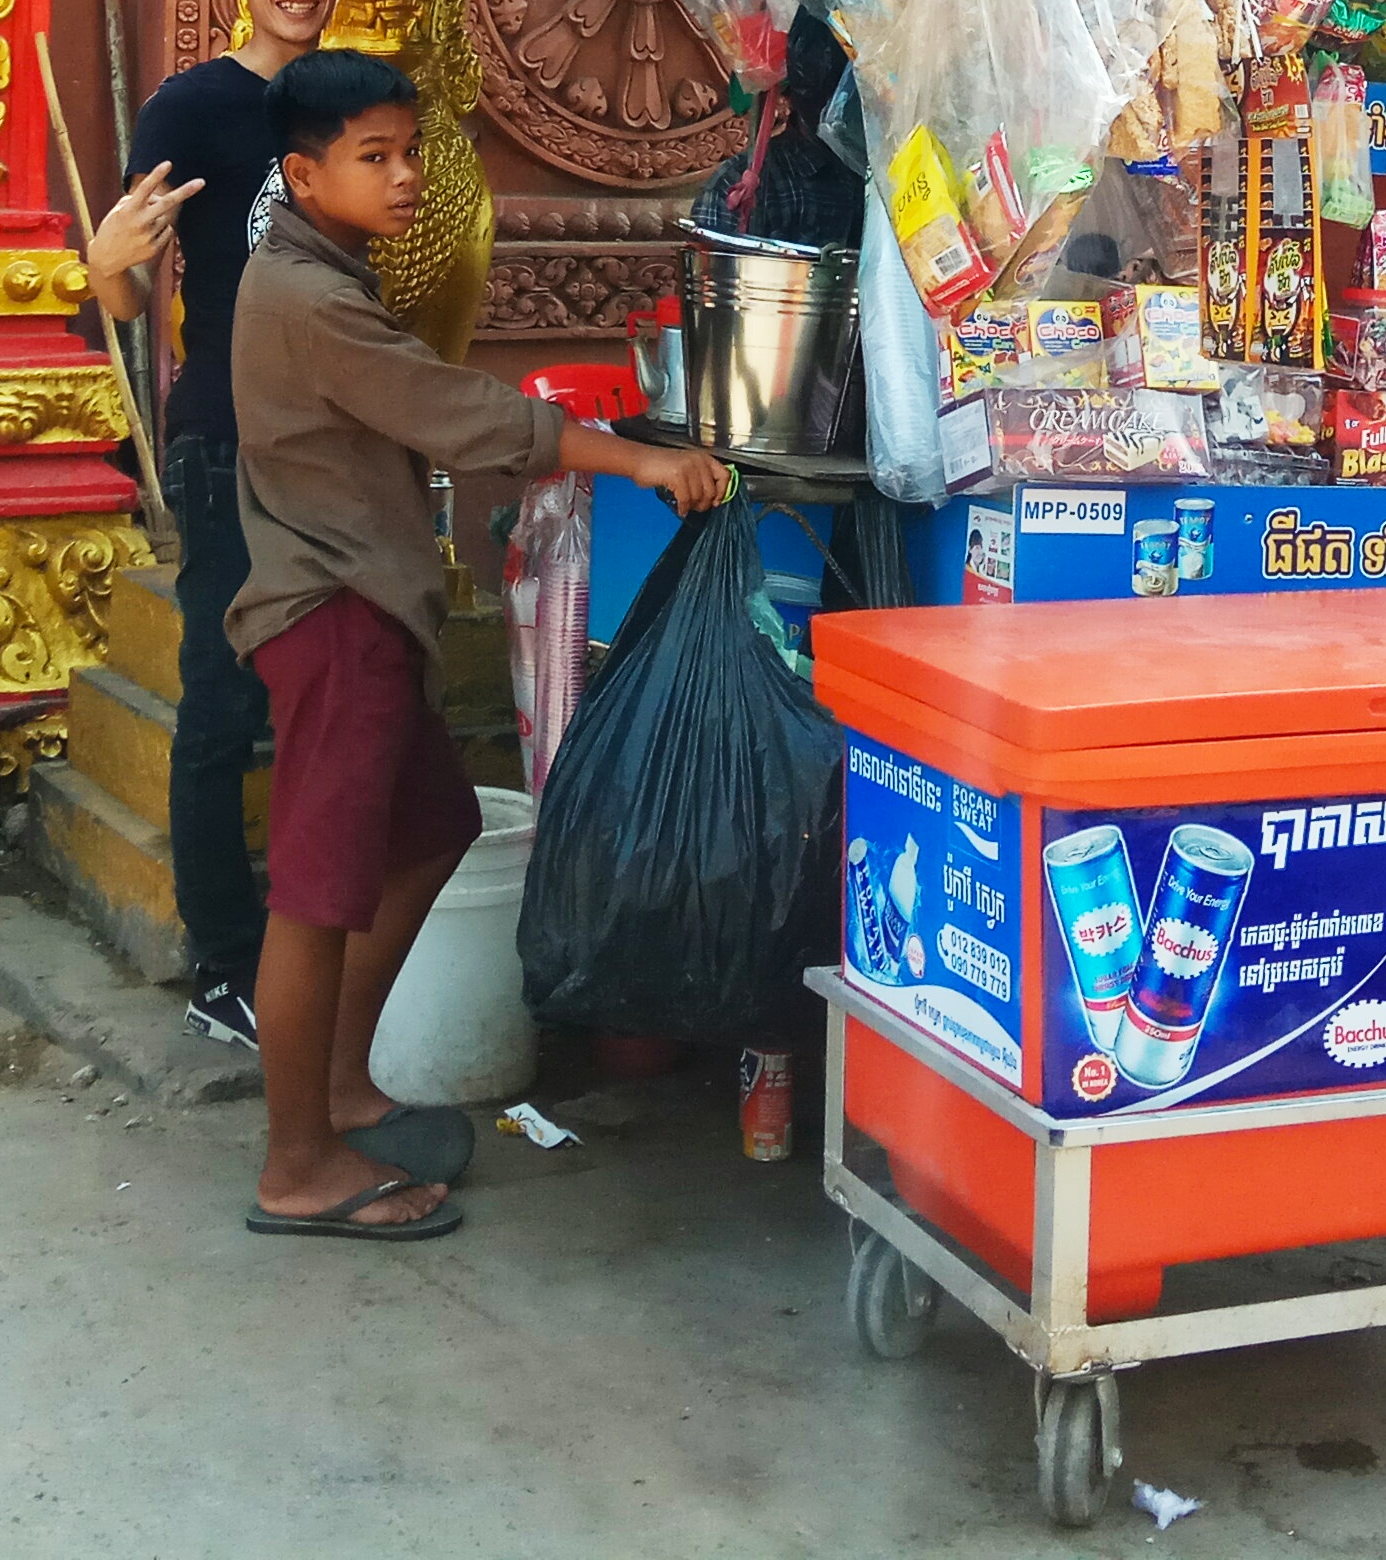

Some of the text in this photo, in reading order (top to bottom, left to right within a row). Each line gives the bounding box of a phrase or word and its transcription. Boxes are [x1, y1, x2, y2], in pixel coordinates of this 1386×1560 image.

[1039, 323, 1098, 339] Choco
[1024, 500, 1124, 522] MPP-0509
[952, 784, 997, 819] POCARI
[952, 801, 994, 832] SWEAT
[1186, 888, 1204, 905] Your
[1079, 915, 1127, 943] 박카스
[951, 931, 969, 954] 012
[989, 952, 1008, 976] 012
[1156, 927, 1213, 962] Bacchus
[970, 964, 988, 987] 779
[989, 975, 1008, 999] 779
[1347, 1043, 1369, 1053] ENERGY
[1084, 1065, 1106, 1077] No. 1
